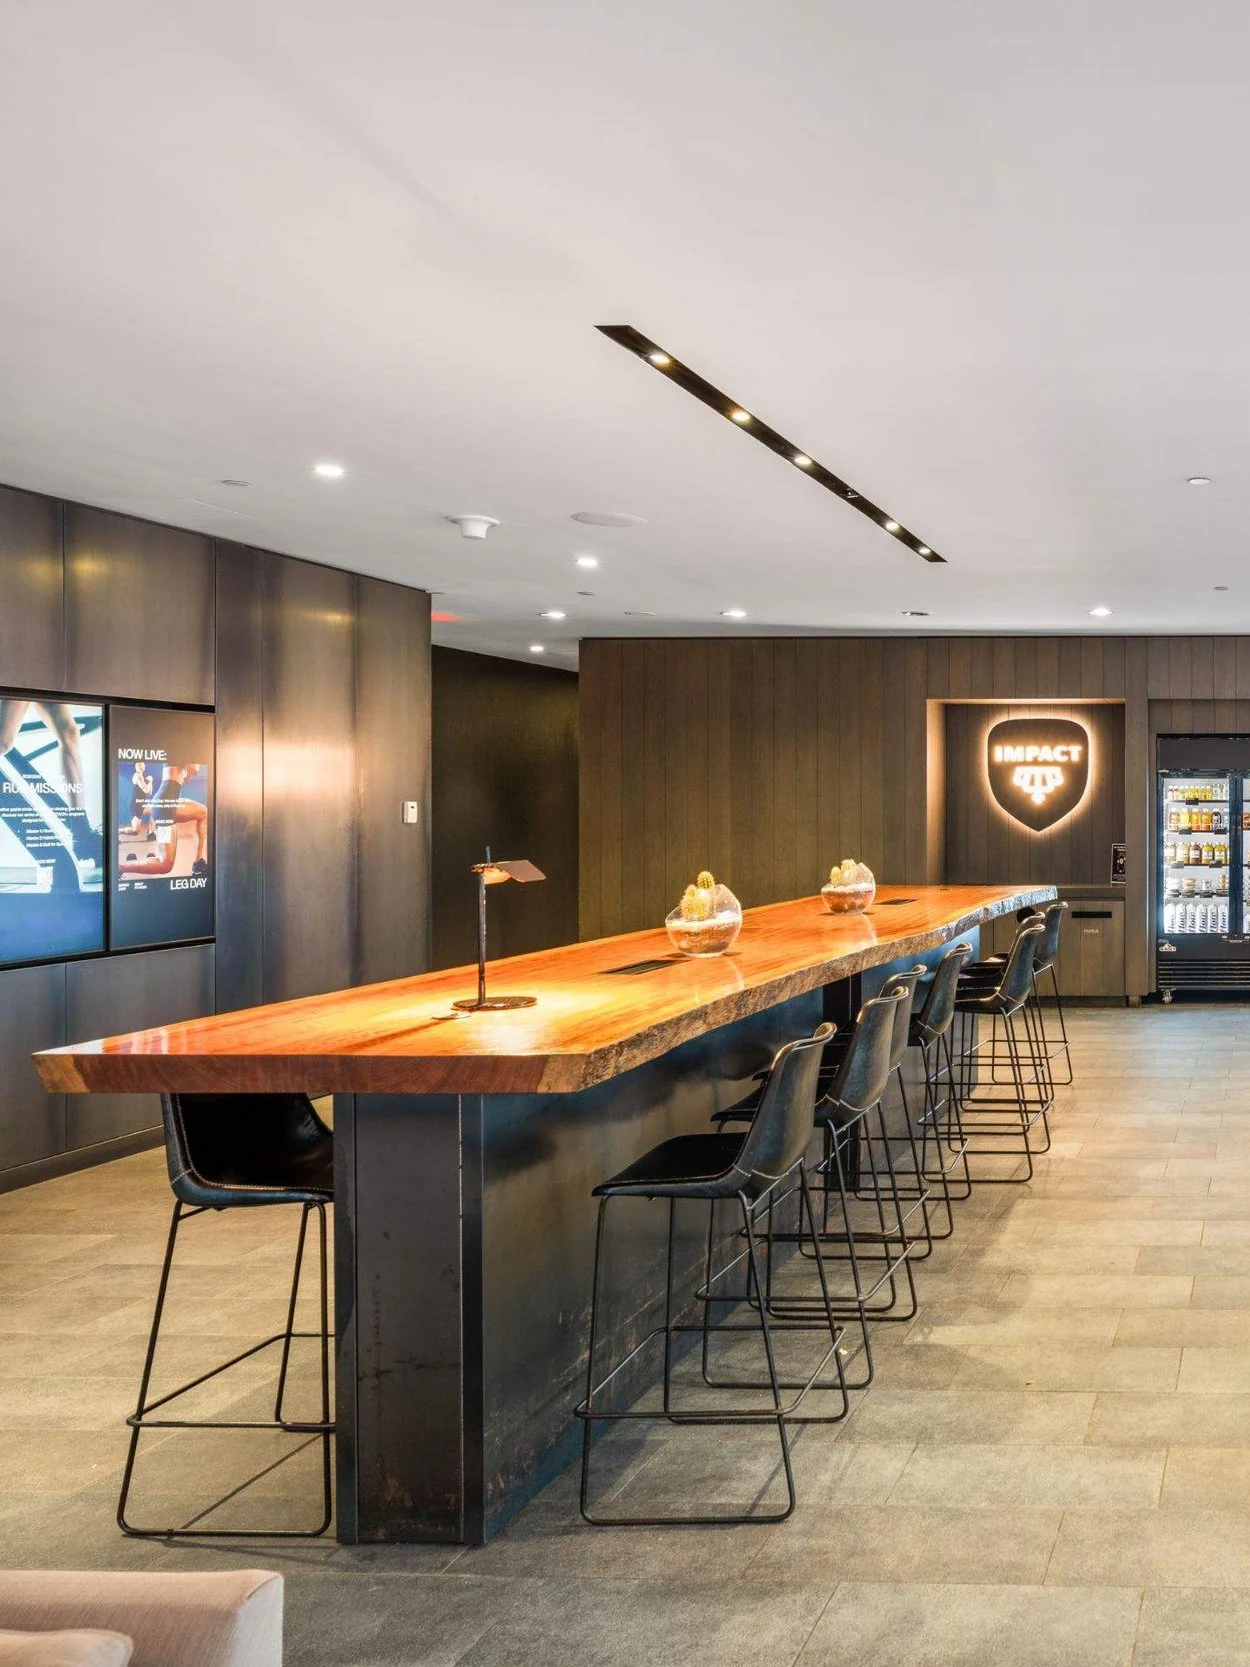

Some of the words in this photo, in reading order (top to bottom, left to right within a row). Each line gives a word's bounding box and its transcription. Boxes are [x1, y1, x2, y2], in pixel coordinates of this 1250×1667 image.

[118, 749, 142, 760] NOW
[145, 750, 167, 760] LIVE:
[993, 745, 1082, 762] IMPACT
[170, 879, 189, 890] LEG
[190, 878, 207, 888] DAY
